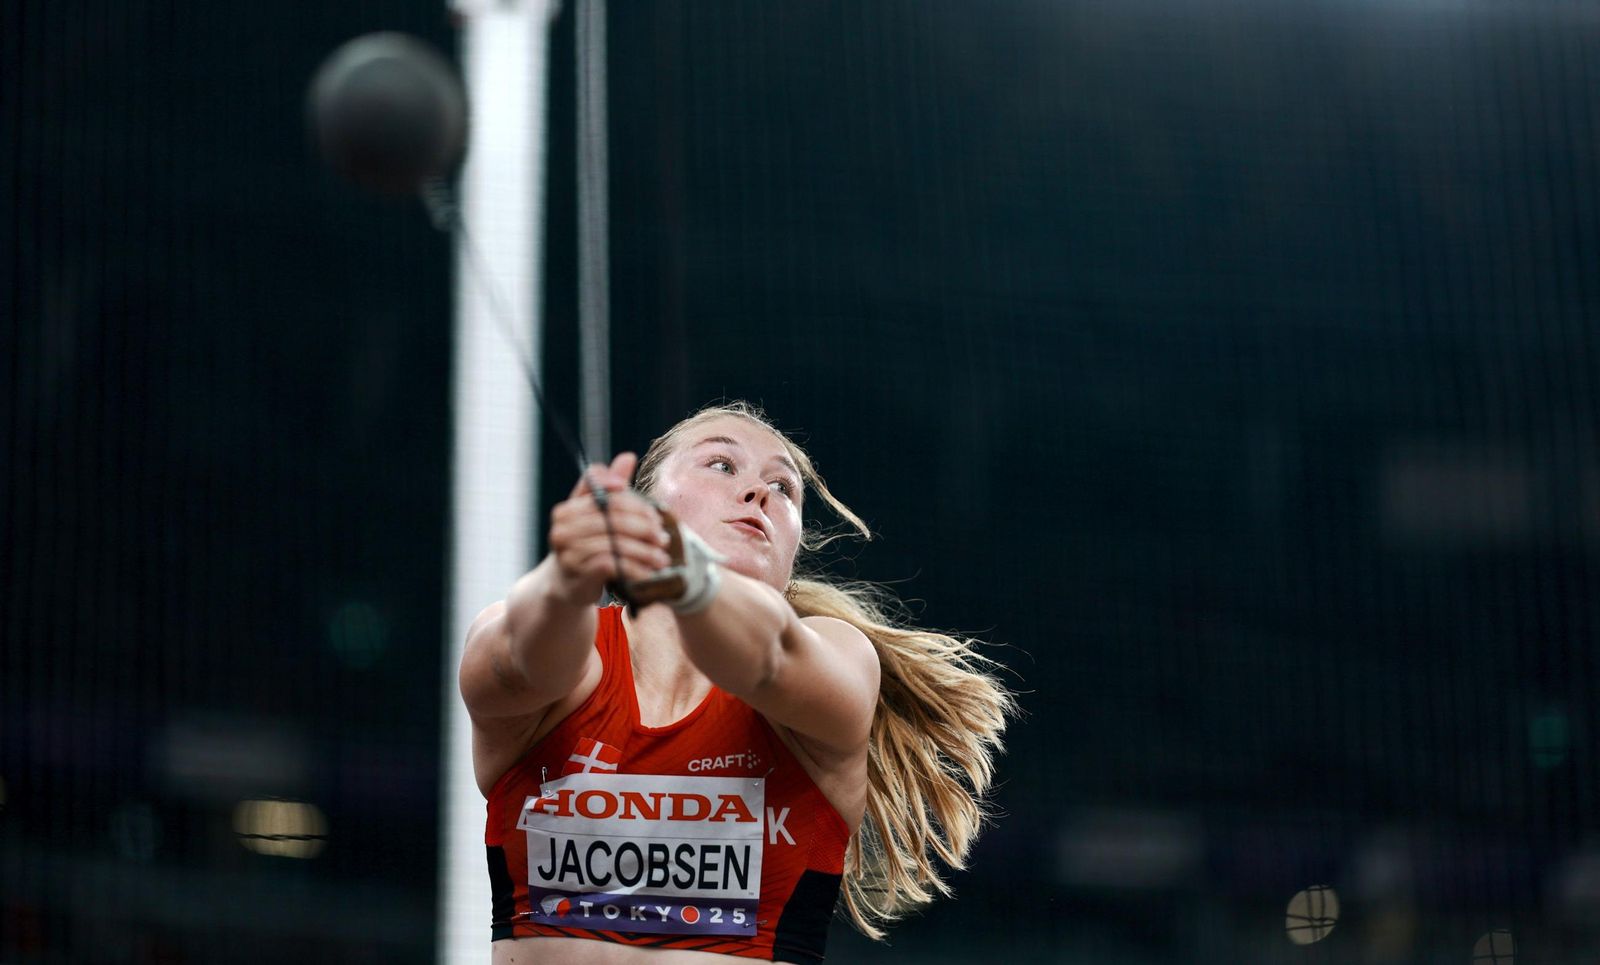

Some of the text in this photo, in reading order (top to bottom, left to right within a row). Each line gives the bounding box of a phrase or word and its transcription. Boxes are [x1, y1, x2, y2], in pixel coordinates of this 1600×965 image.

[688, 754, 745, 772] CRAFT
[530, 789, 758, 823] HONDA
[537, 837, 751, 890] JACOBSEN
[709, 908, 746, 924] 25
